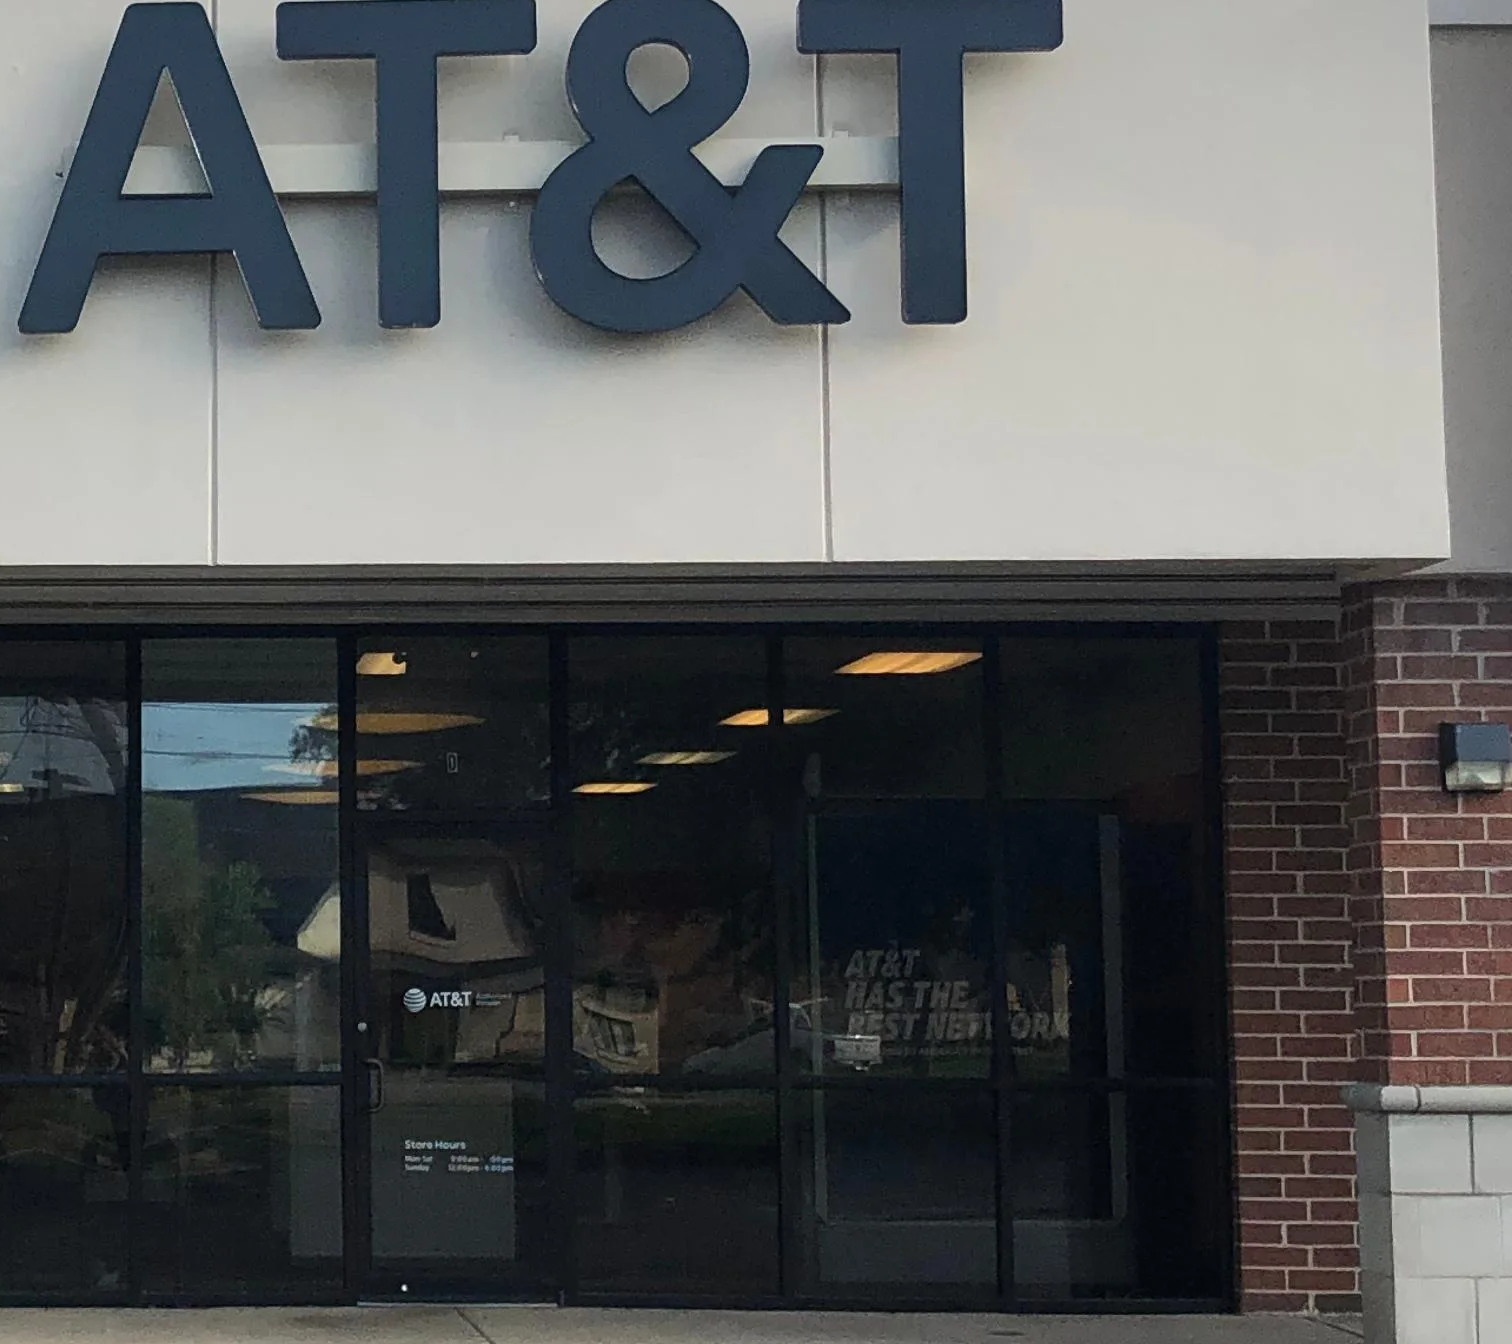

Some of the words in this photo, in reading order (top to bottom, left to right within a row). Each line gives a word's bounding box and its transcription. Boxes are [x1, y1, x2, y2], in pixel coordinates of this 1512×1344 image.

[844, 949, 921, 978] AT&T
[429, 991, 472, 1007] AT&T
[844, 980, 905, 1009] HAS
[913, 979, 970, 1009] THE
[404, 1140, 433, 1150] Store
[434, 1140, 466, 1150] Hours
